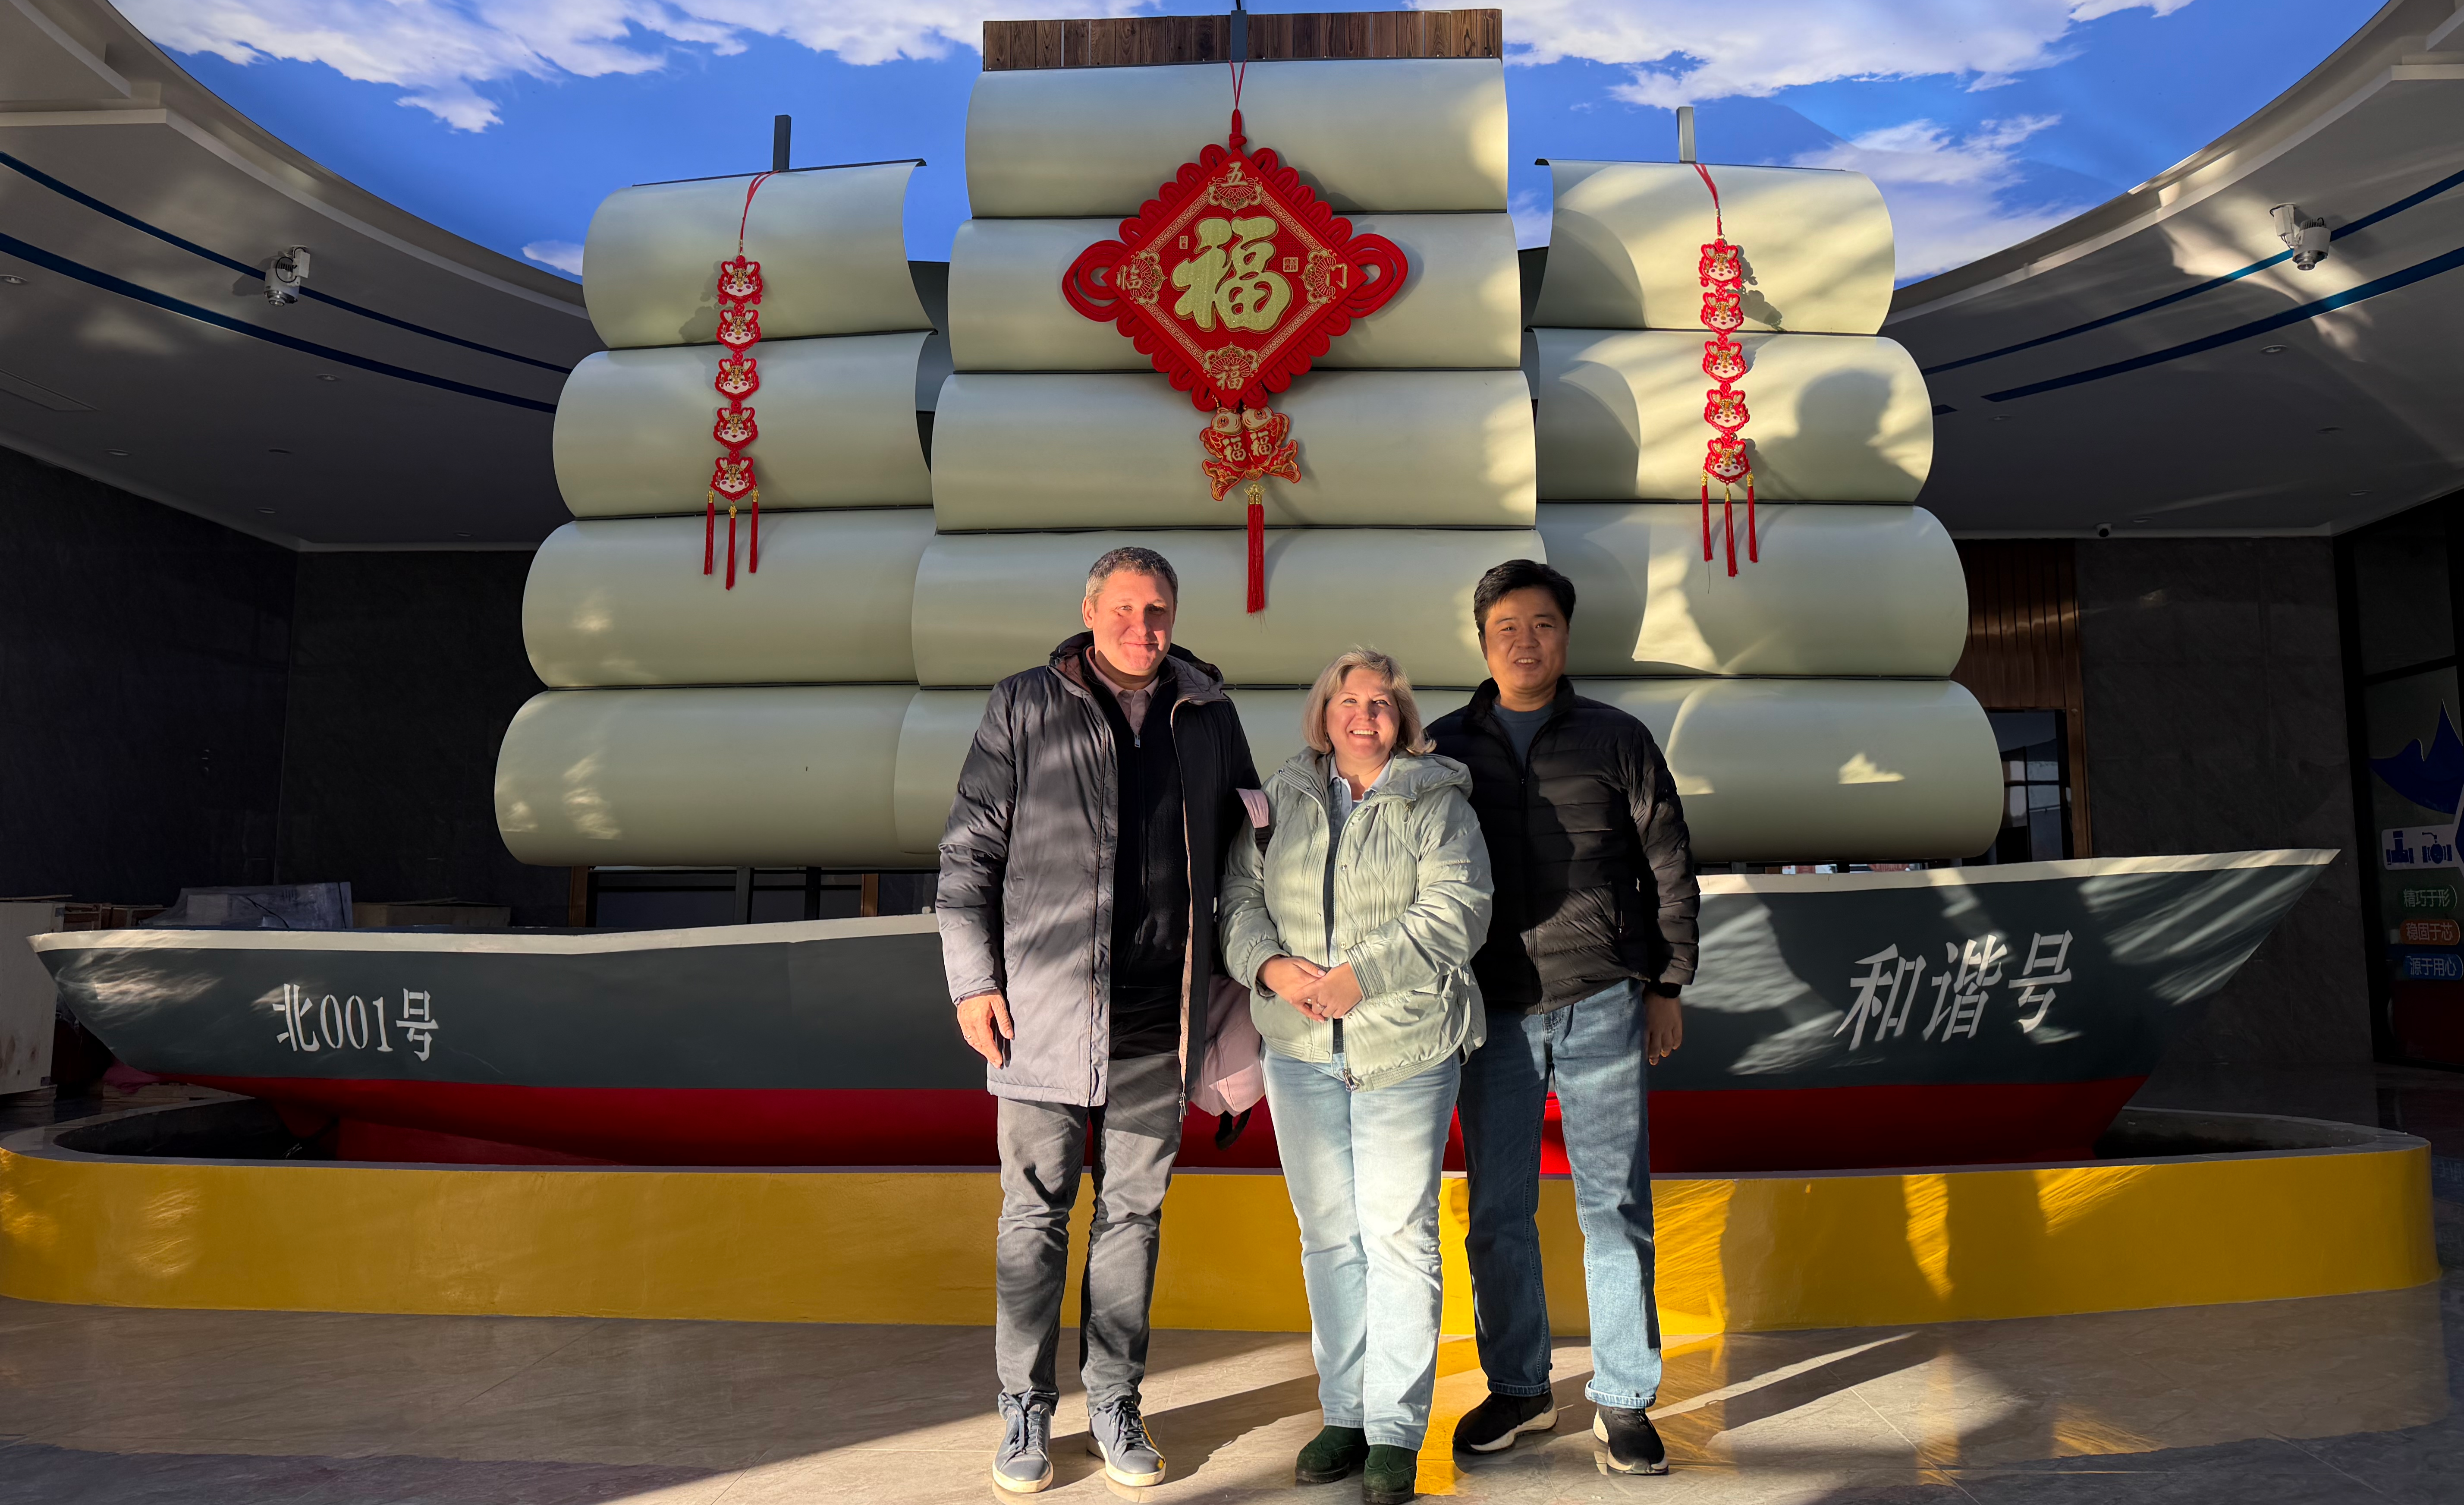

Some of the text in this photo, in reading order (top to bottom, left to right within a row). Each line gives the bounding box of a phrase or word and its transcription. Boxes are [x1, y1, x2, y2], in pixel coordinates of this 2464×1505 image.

[1220, 161, 1248, 187] 五
[1116, 265, 1143, 290] 临
[1171, 216, 1293, 334] 福
[1325, 263, 1348, 290] 门
[1214, 364, 1245, 390] 福
[1223, 436, 1246, 462] 福
[1251, 431, 1272, 457] 福
[2403, 888, 2450, 907] 精巧于形
[2406, 922, 2453, 941] 稳固于芯
[2410, 957, 2457, 976] 源于用心
[1833, 930, 2073, 1050] 和谐号
[272, 983, 439, 1061] 北001号
